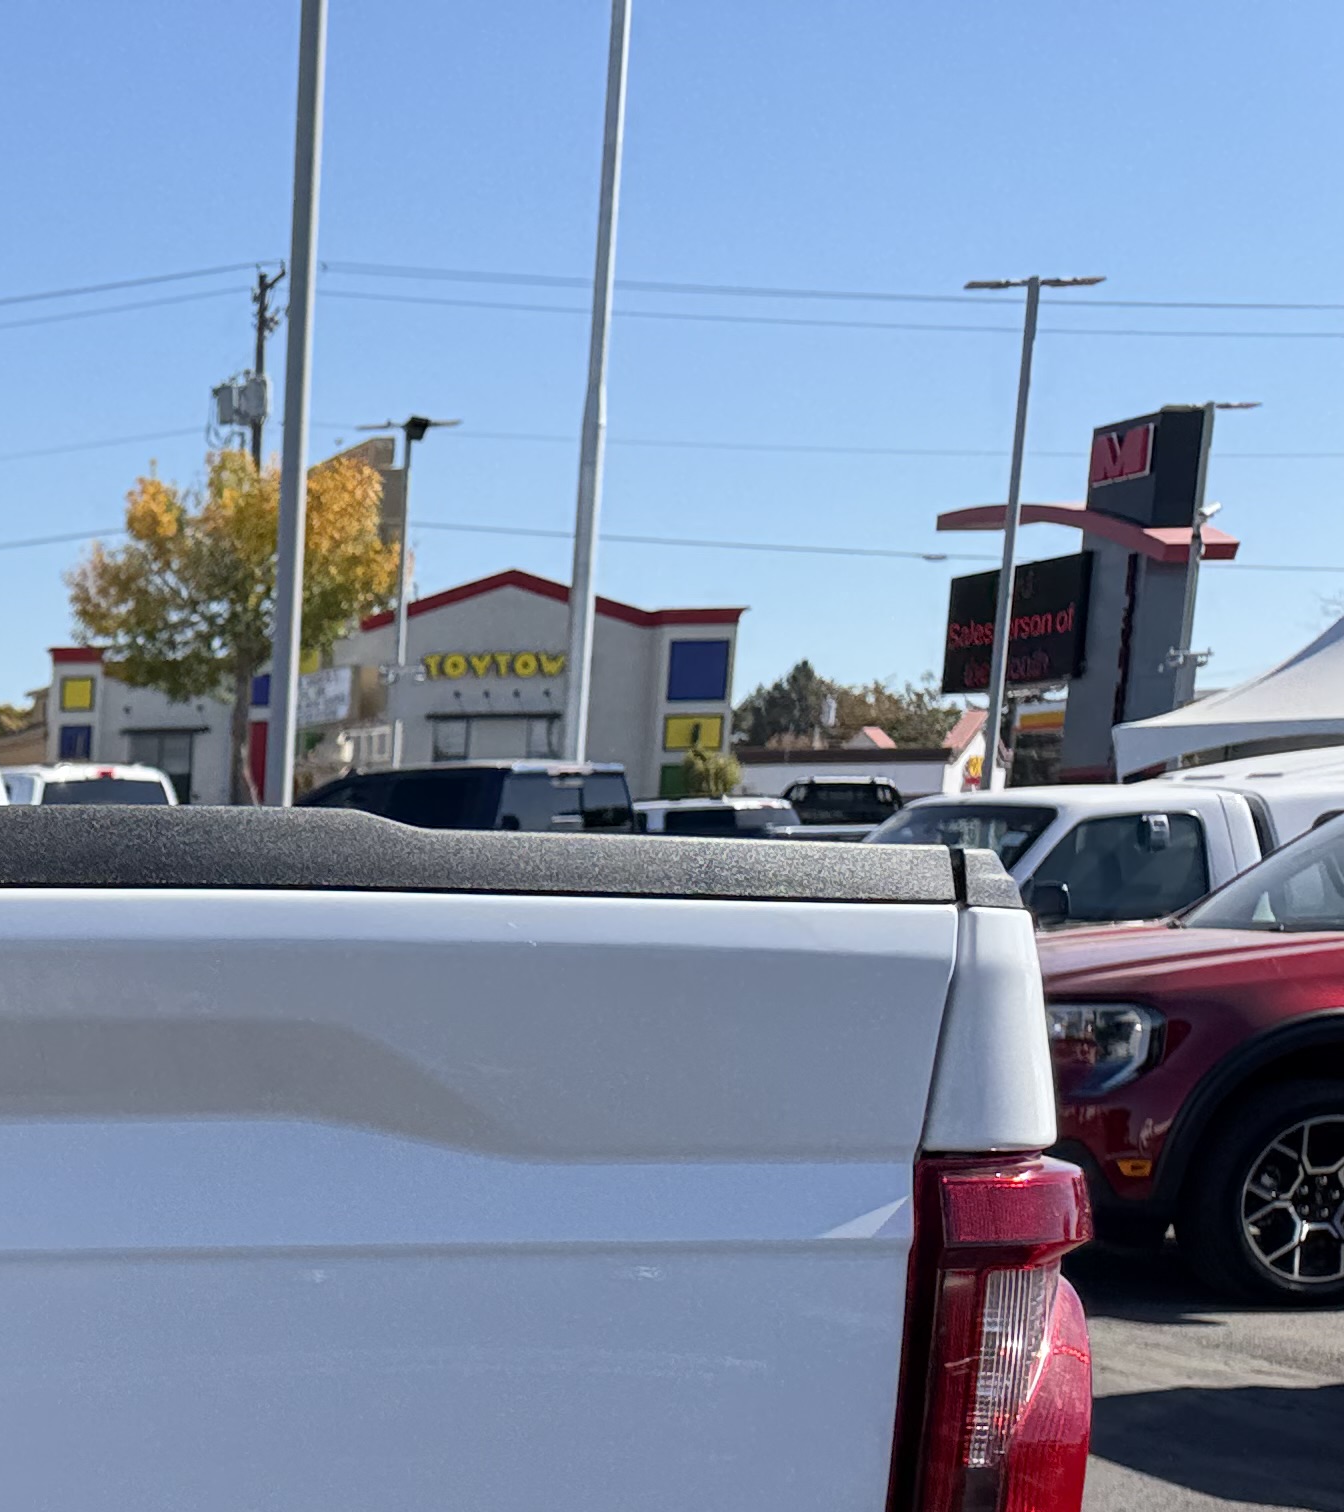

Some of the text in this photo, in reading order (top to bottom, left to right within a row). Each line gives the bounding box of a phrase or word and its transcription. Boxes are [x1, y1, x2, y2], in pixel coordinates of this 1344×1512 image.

[948, 602, 1076, 649] Salesrson of
[424, 652, 565, 678] TOYTOW
